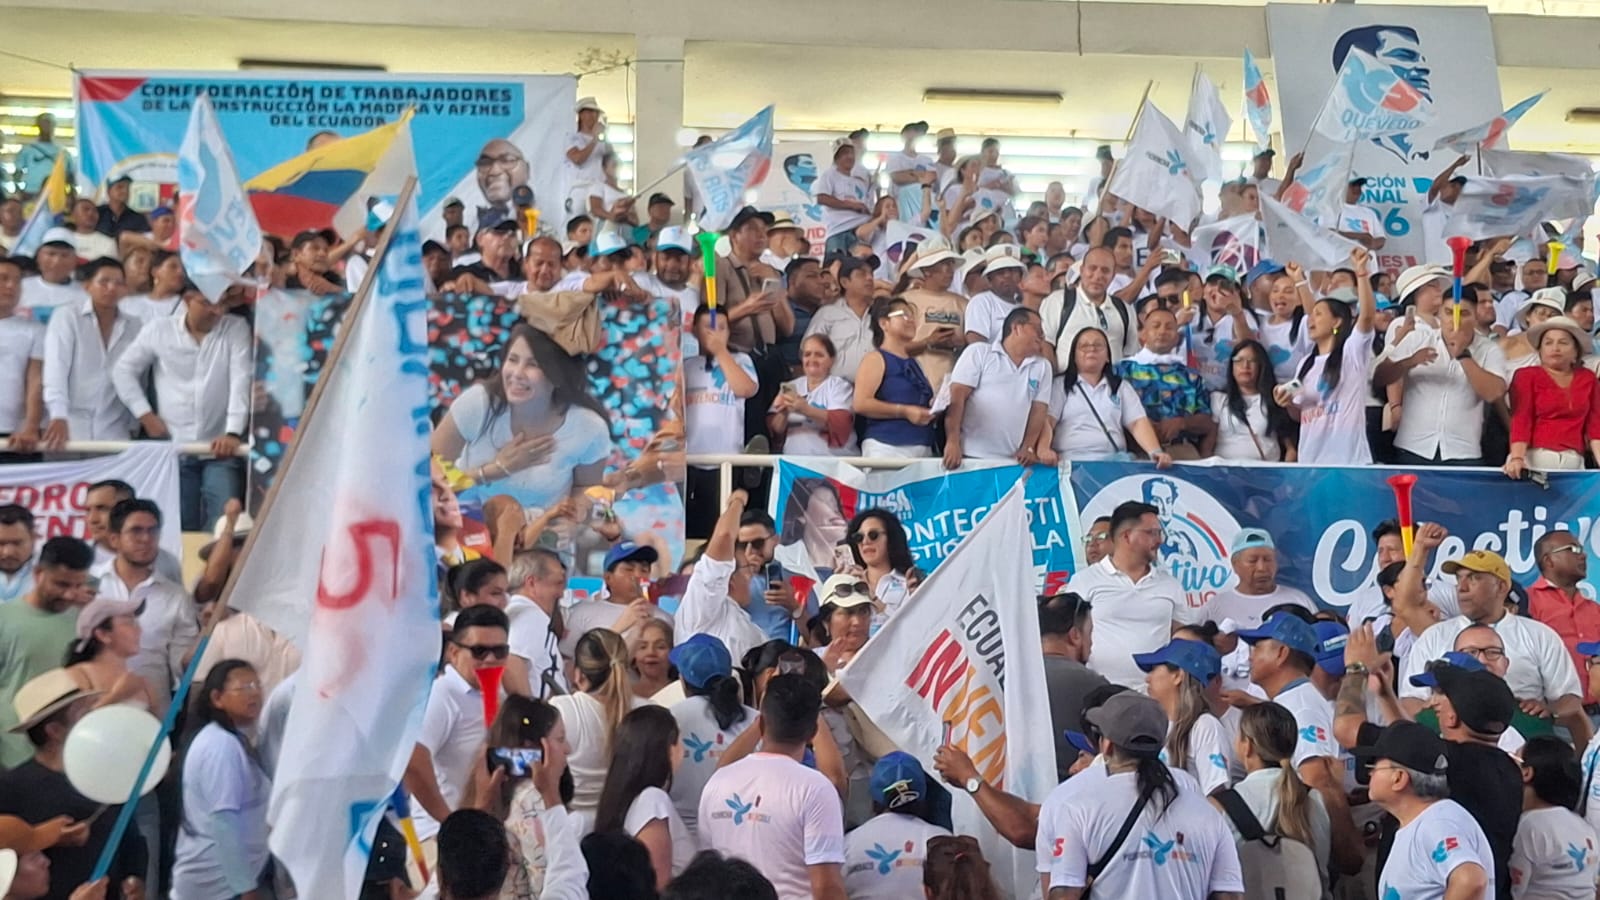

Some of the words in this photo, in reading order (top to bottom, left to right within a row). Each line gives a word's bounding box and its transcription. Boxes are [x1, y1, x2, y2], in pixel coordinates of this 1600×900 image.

[321, 86, 345, 99] DE
[352, 86, 511, 102] TRABAJADORES
[142, 102, 163, 112] DE
[169, 101, 191, 112] LA
[333, 103, 353, 113] LA
[436, 104, 445, 115] Y
[448, 103, 511, 116] AFINES
[270, 115, 303, 126] DEL
[309, 115, 387, 127] ECUADOR
[1171, 559, 1232, 592] tivo
